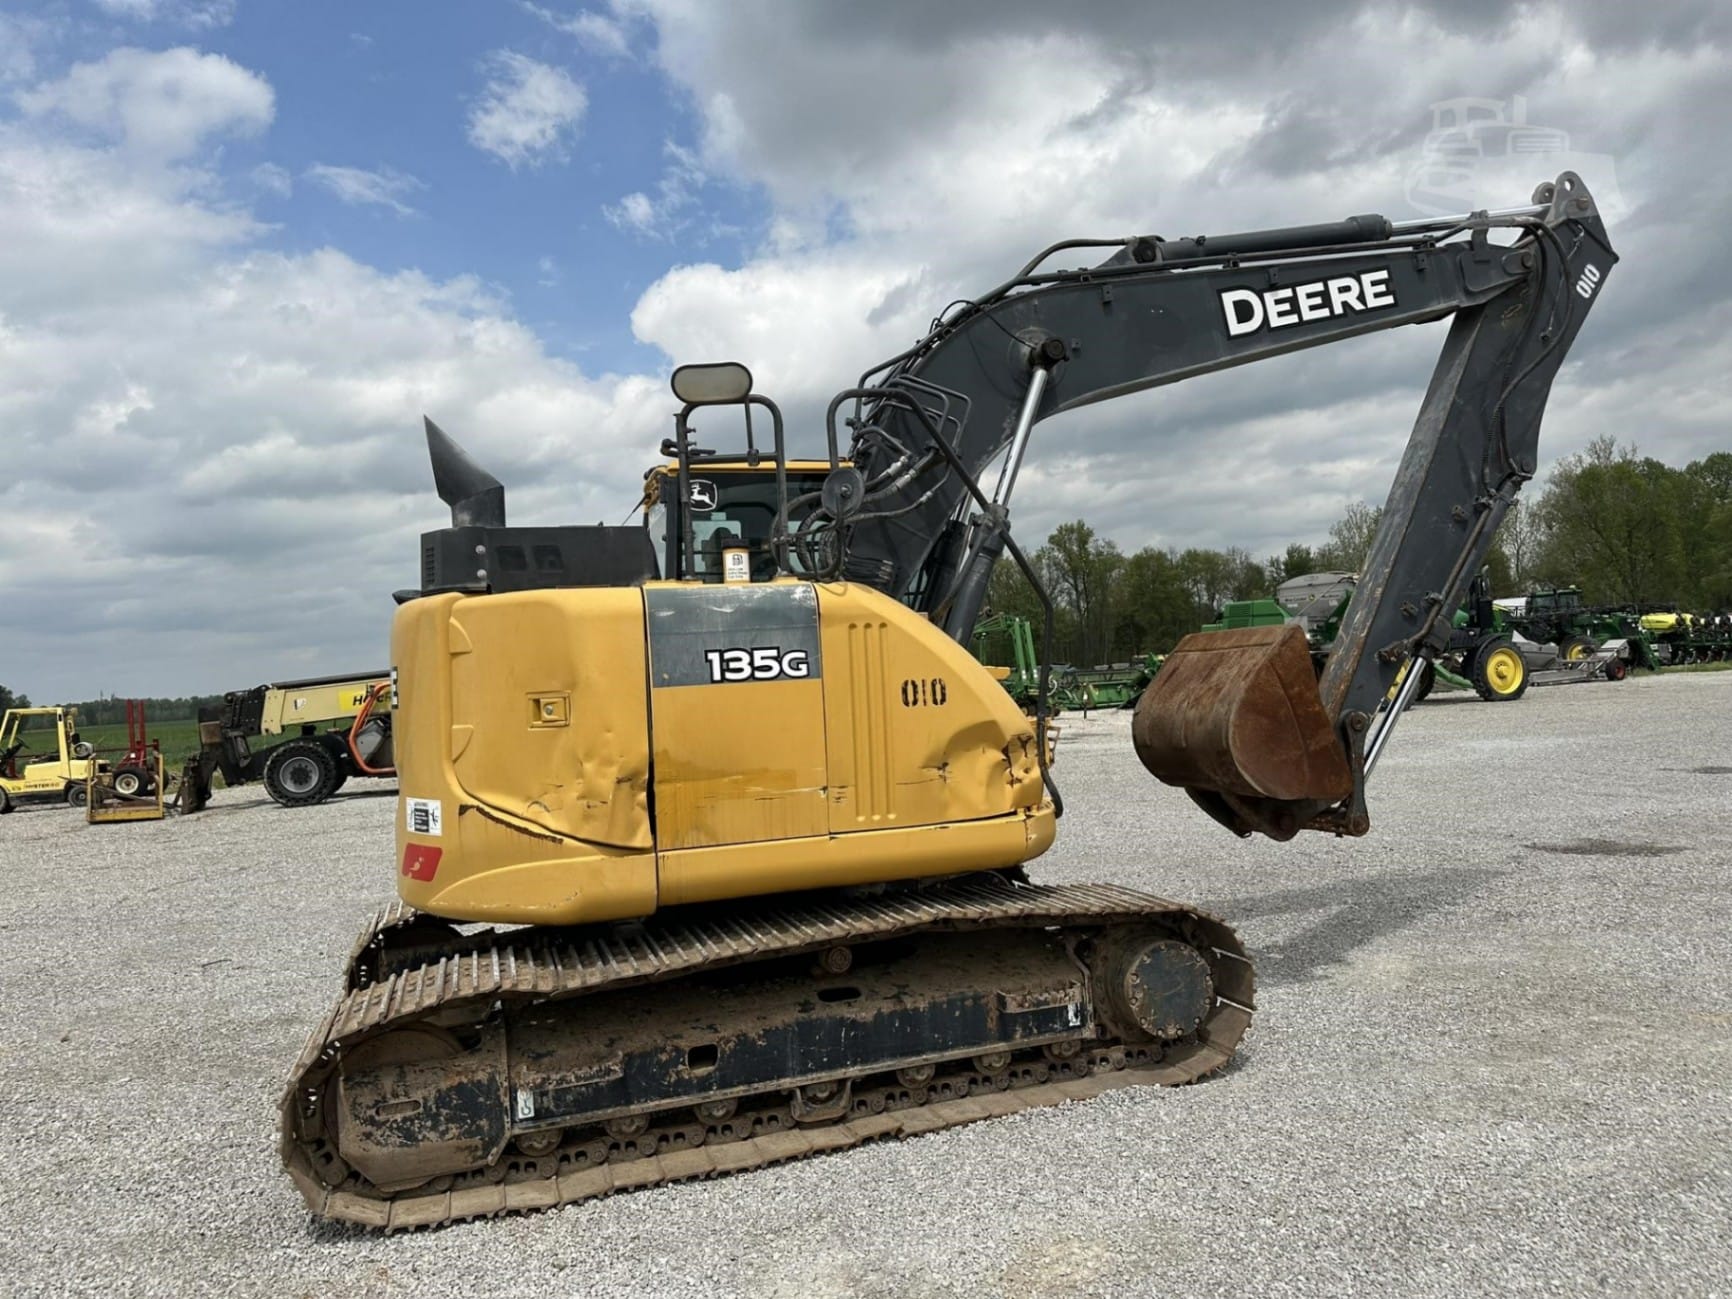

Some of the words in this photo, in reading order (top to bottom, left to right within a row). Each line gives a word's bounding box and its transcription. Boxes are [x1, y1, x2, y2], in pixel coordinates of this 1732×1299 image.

[1575, 263, 1601, 299] 010
[1220, 268, 1396, 337] DEERE
[705, 647, 810, 683] 135G
[901, 677, 947, 708] 010
